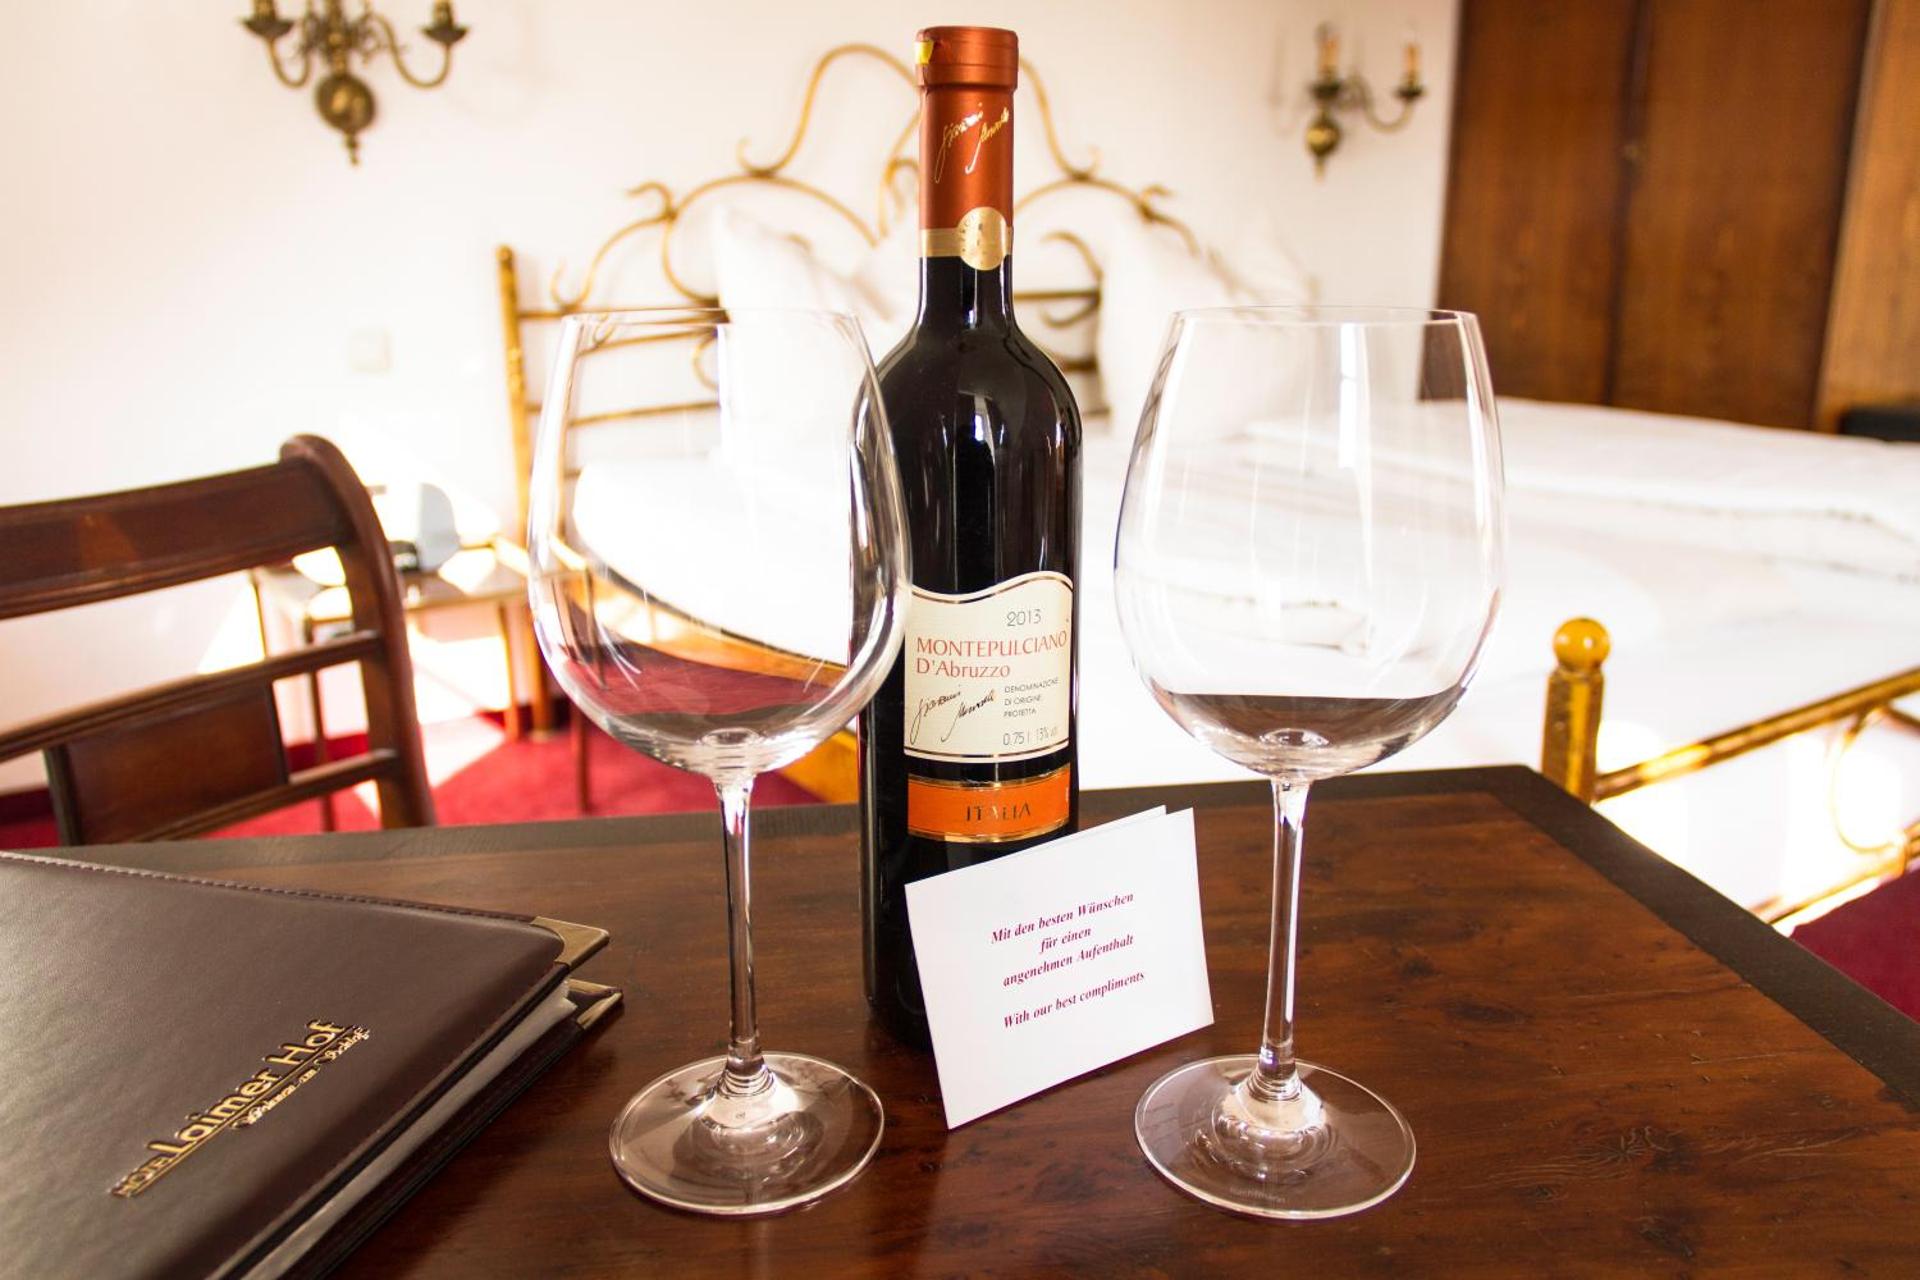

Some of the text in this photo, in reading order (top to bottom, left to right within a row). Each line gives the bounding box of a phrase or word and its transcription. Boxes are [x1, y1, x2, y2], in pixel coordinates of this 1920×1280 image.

[1006, 609, 1042, 627] 2013
[916, 630, 1067, 657] MONTEPULCIANO
[916, 657, 1011, 678] D'Abruzzo
[1004, 677, 1059, 694] DENOMINAZIONE
[1004, 694, 1042, 706] DI ORIGINE
[1003, 707, 1037, 718] PROTETTA
[966, 803, 1031, 821] ITALIA
[991, 893, 1134, 944] Mit den besten Wünschen
[1039, 927, 1092, 954] für einen
[1003, 933, 1134, 987] angenehmen Aufenthalt
[1004, 971, 1145, 1028] With our best compliments
[147, 1067, 282, 1153] Laimer
[263, 1019, 346, 1066] Hof
